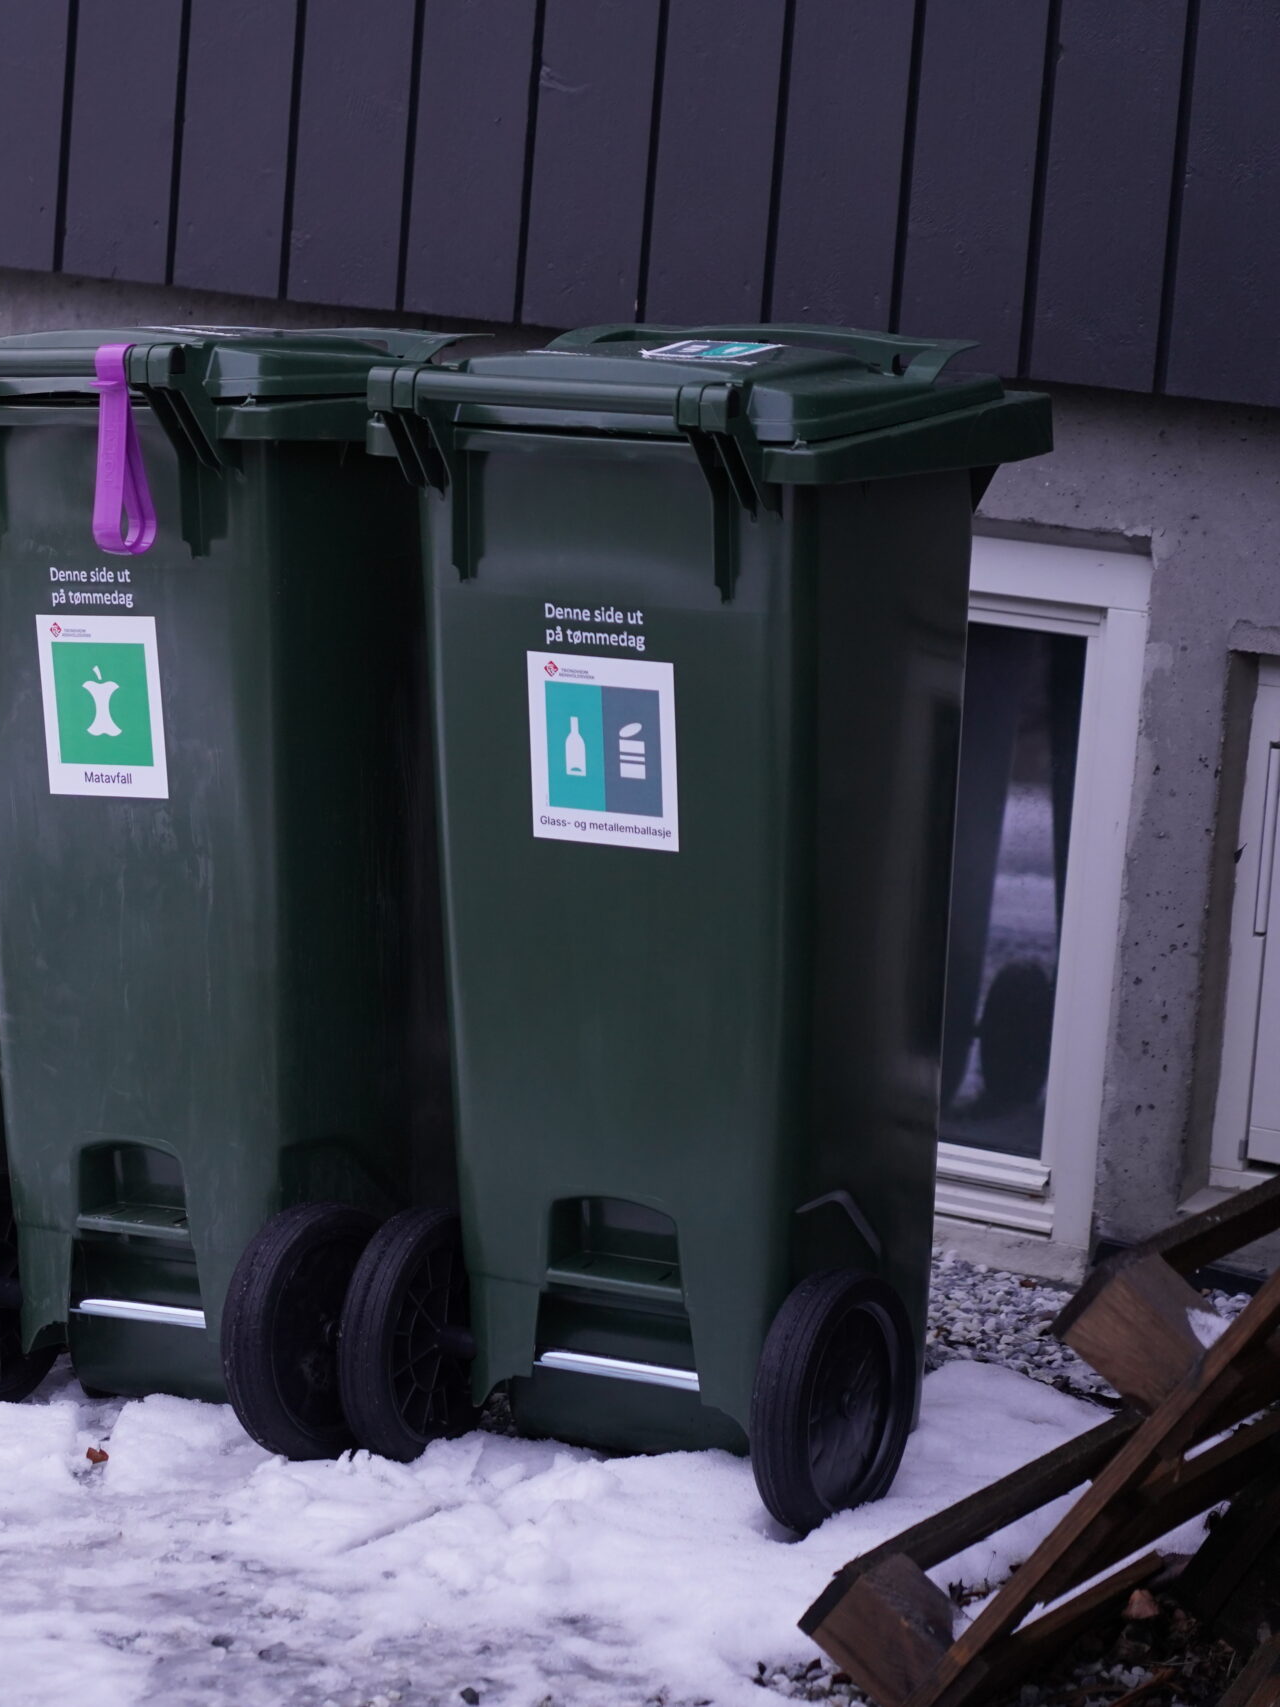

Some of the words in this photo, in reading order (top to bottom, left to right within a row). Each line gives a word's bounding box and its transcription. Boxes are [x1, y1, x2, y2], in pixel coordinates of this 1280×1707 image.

[49, 566, 88, 582] Denne
[90, 566, 115, 583] side
[117, 568, 132, 583] ut
[51, 588, 67, 607] på
[68, 589, 134, 608] tømmedag
[544, 602, 591, 621] Denne
[594, 606, 624, 624] side
[627, 610, 644, 625] ut
[545, 625, 564, 645] på
[566, 628, 646, 652] tømmedag
[84, 771, 133, 785] Matavfall
[539, 815, 572, 828] Glass-
[574, 820, 587, 832] og
[589, 820, 672, 839] metallemballasje
